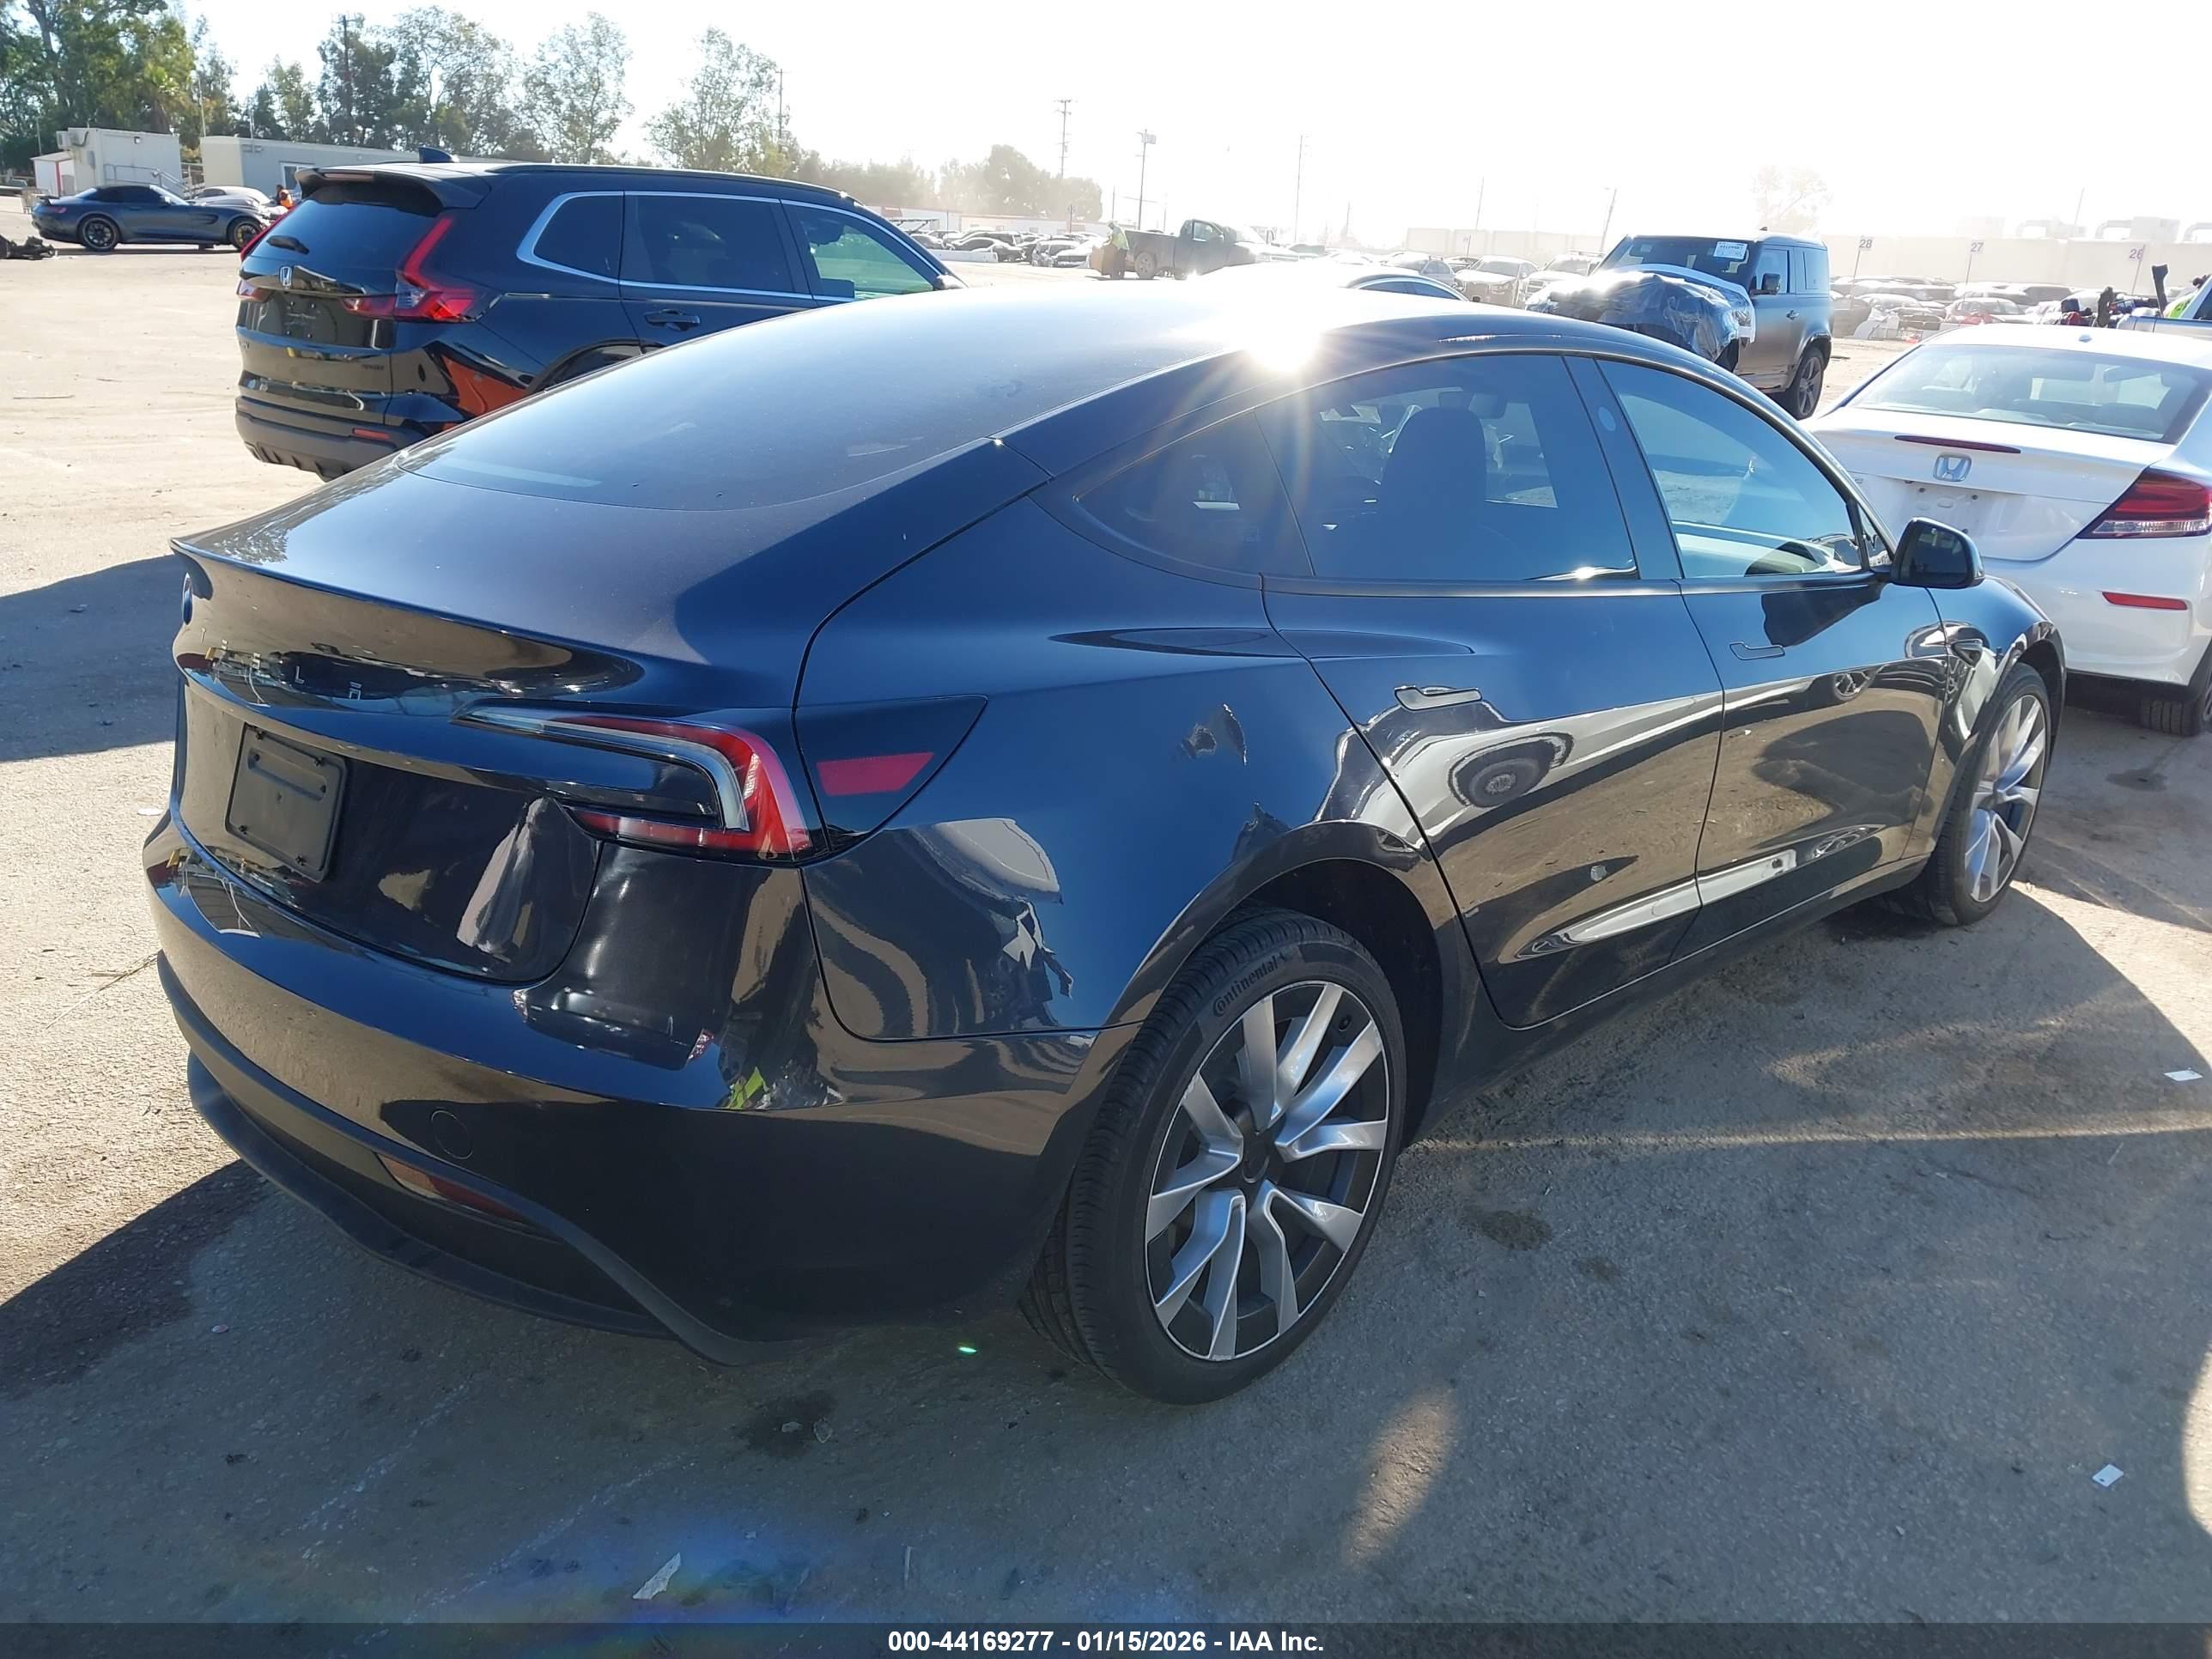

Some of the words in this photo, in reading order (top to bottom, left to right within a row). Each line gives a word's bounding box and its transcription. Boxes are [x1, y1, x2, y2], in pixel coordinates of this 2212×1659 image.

[1859, 239, 1873, 248] 28
[1971, 242, 1984, 252] 27
[1212, 957, 1279, 1017] Continental
